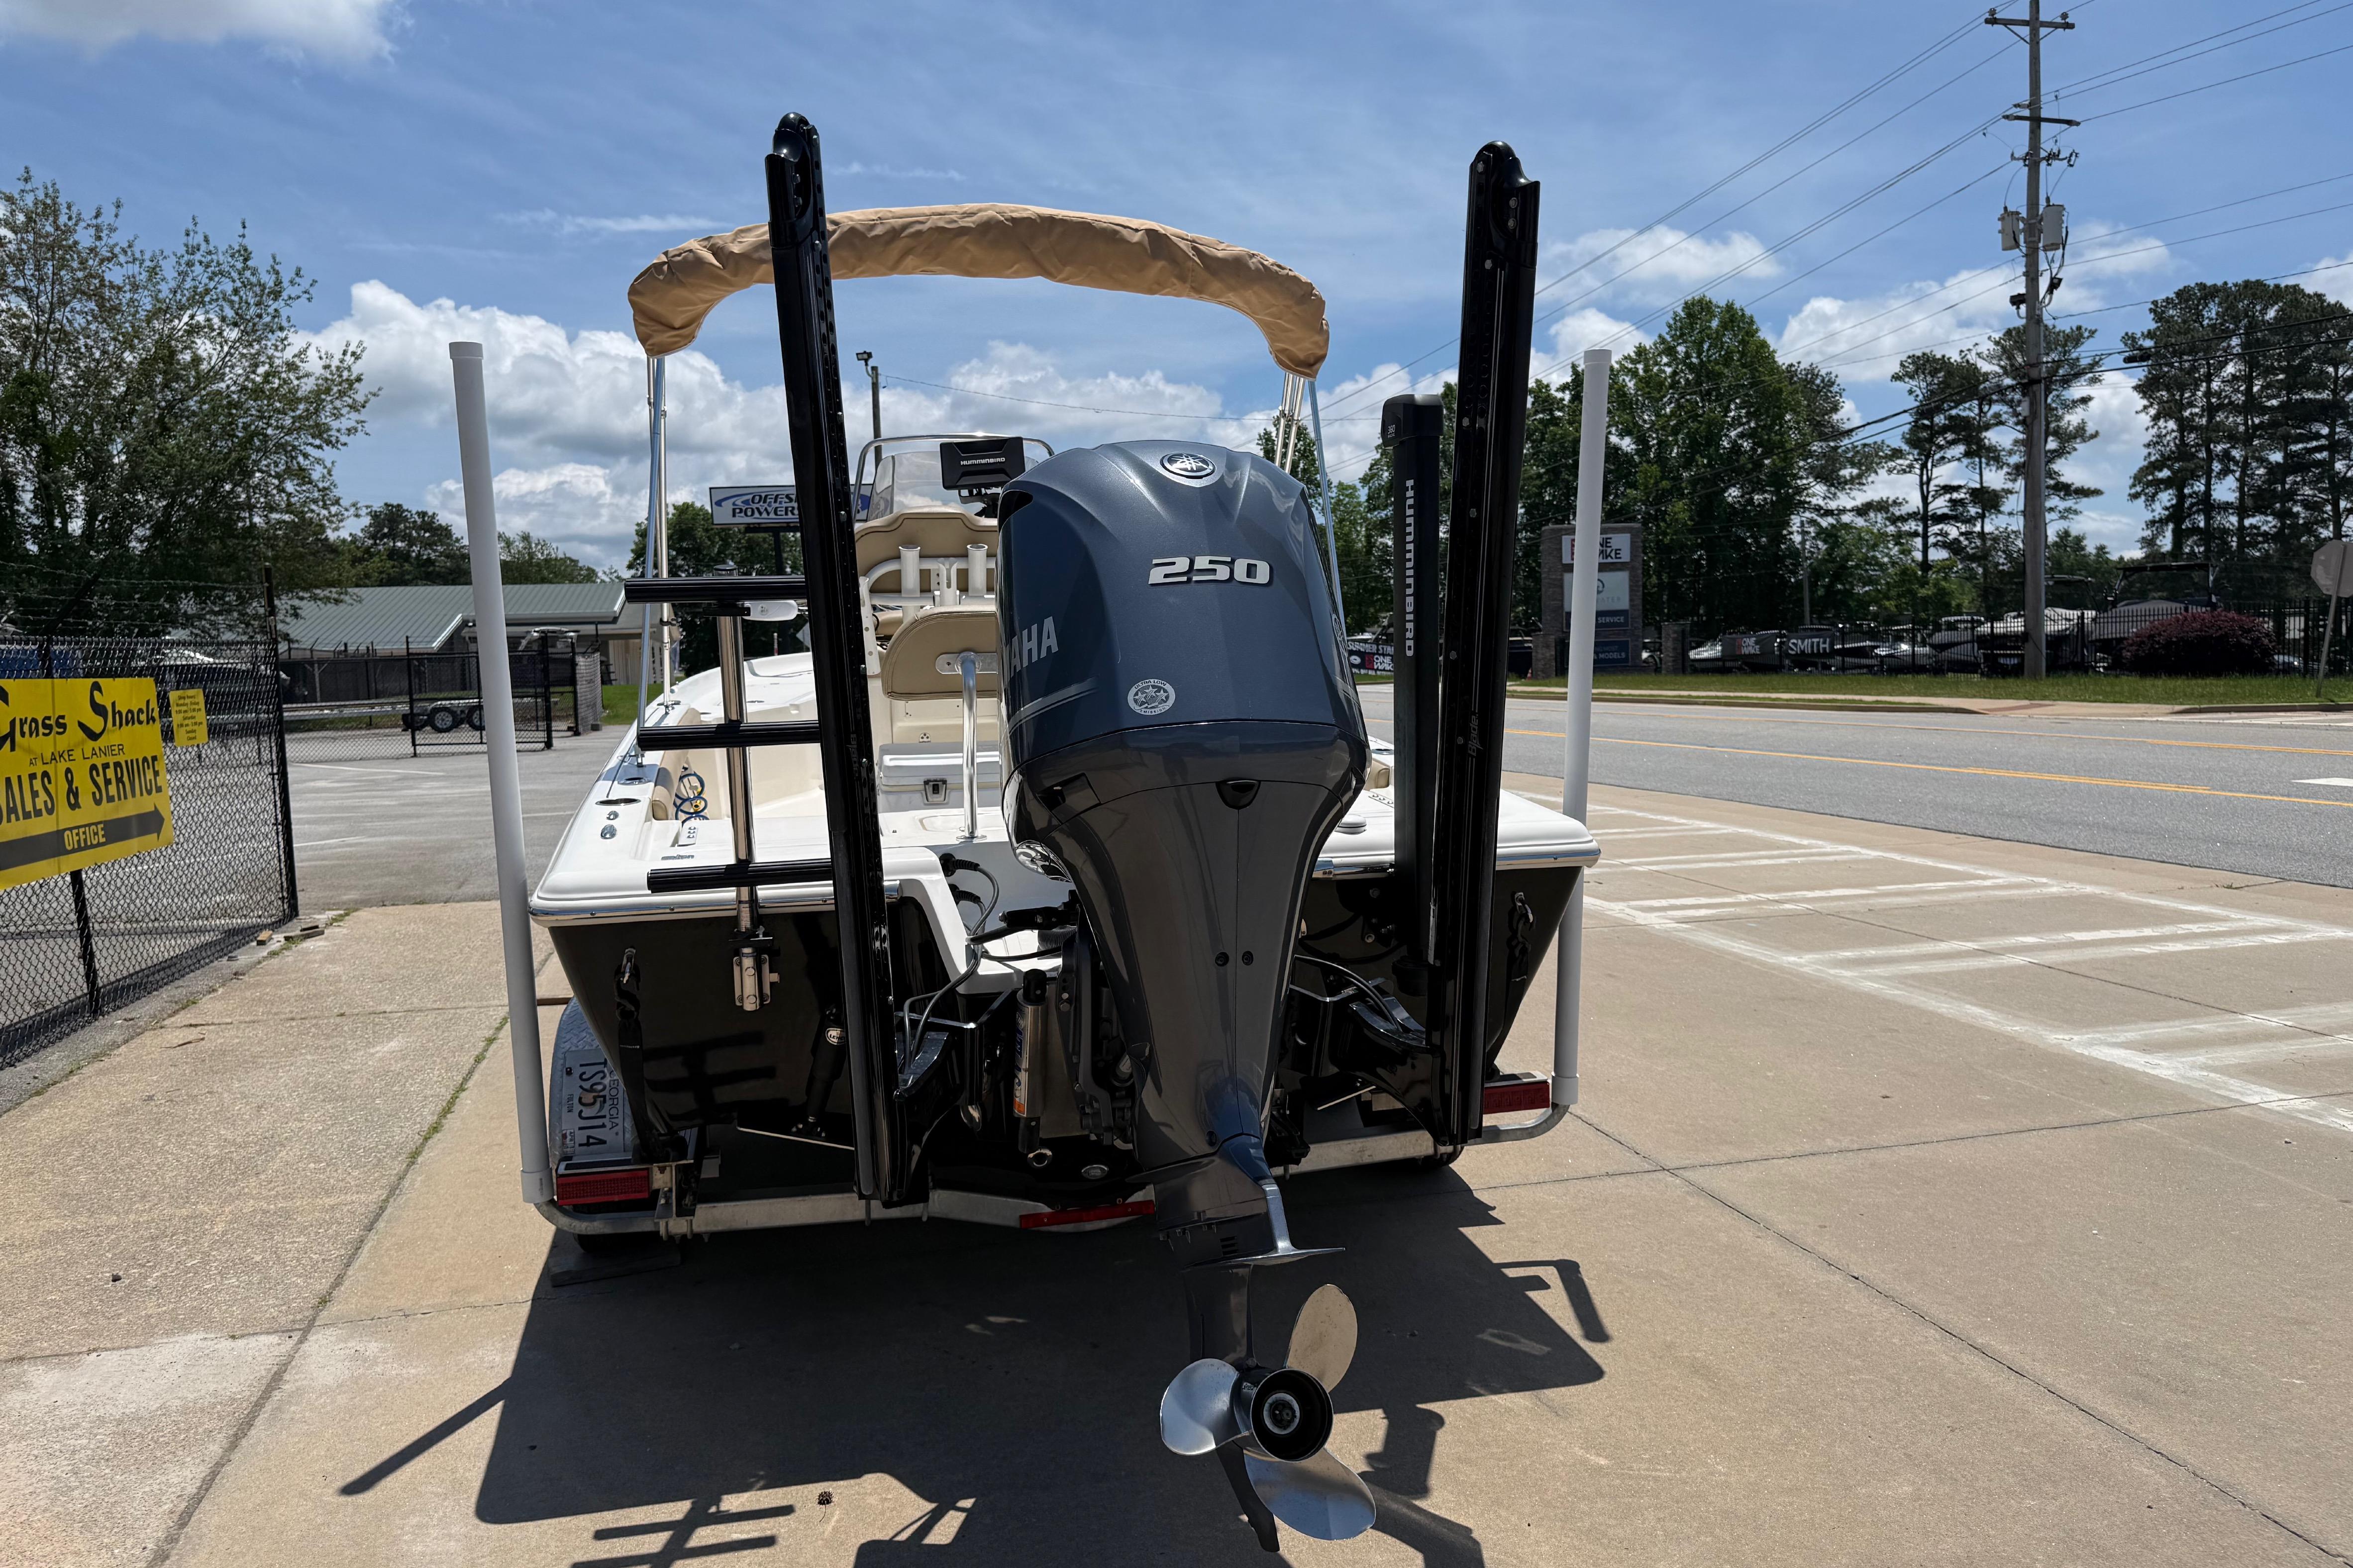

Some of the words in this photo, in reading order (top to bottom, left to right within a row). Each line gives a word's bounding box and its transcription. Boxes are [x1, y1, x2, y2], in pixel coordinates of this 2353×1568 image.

[751, 494, 796, 504] OFFS
[732, 506, 797, 518] POWER
[1599, 549, 1622, 560] AKE
[1148, 556, 1269, 585] 250
[1347, 641, 1377, 653] SUMMER
[1378, 645, 1394, 654] STA
[1742, 638, 1756, 646] ONE
[1788, 638, 1829, 654] SMITH
[1741, 646, 1760, 655] WAKE
[1374, 655, 1392, 663] ONE
[77, 681, 156, 741] Shack
[29, 758, 38, 767] AT
[41, 749, 76, 765] LAKE
[82, 744, 125, 760] LANIER
[0, 770, 55, 825] ALES
[65, 767, 82, 811] &
[89, 755, 163, 807] SERVICE
[64, 824, 106, 851] OFFICE
[578, 1058, 608, 1147] TS95J14
[609, 1070, 619, 1130] GEORGIA
